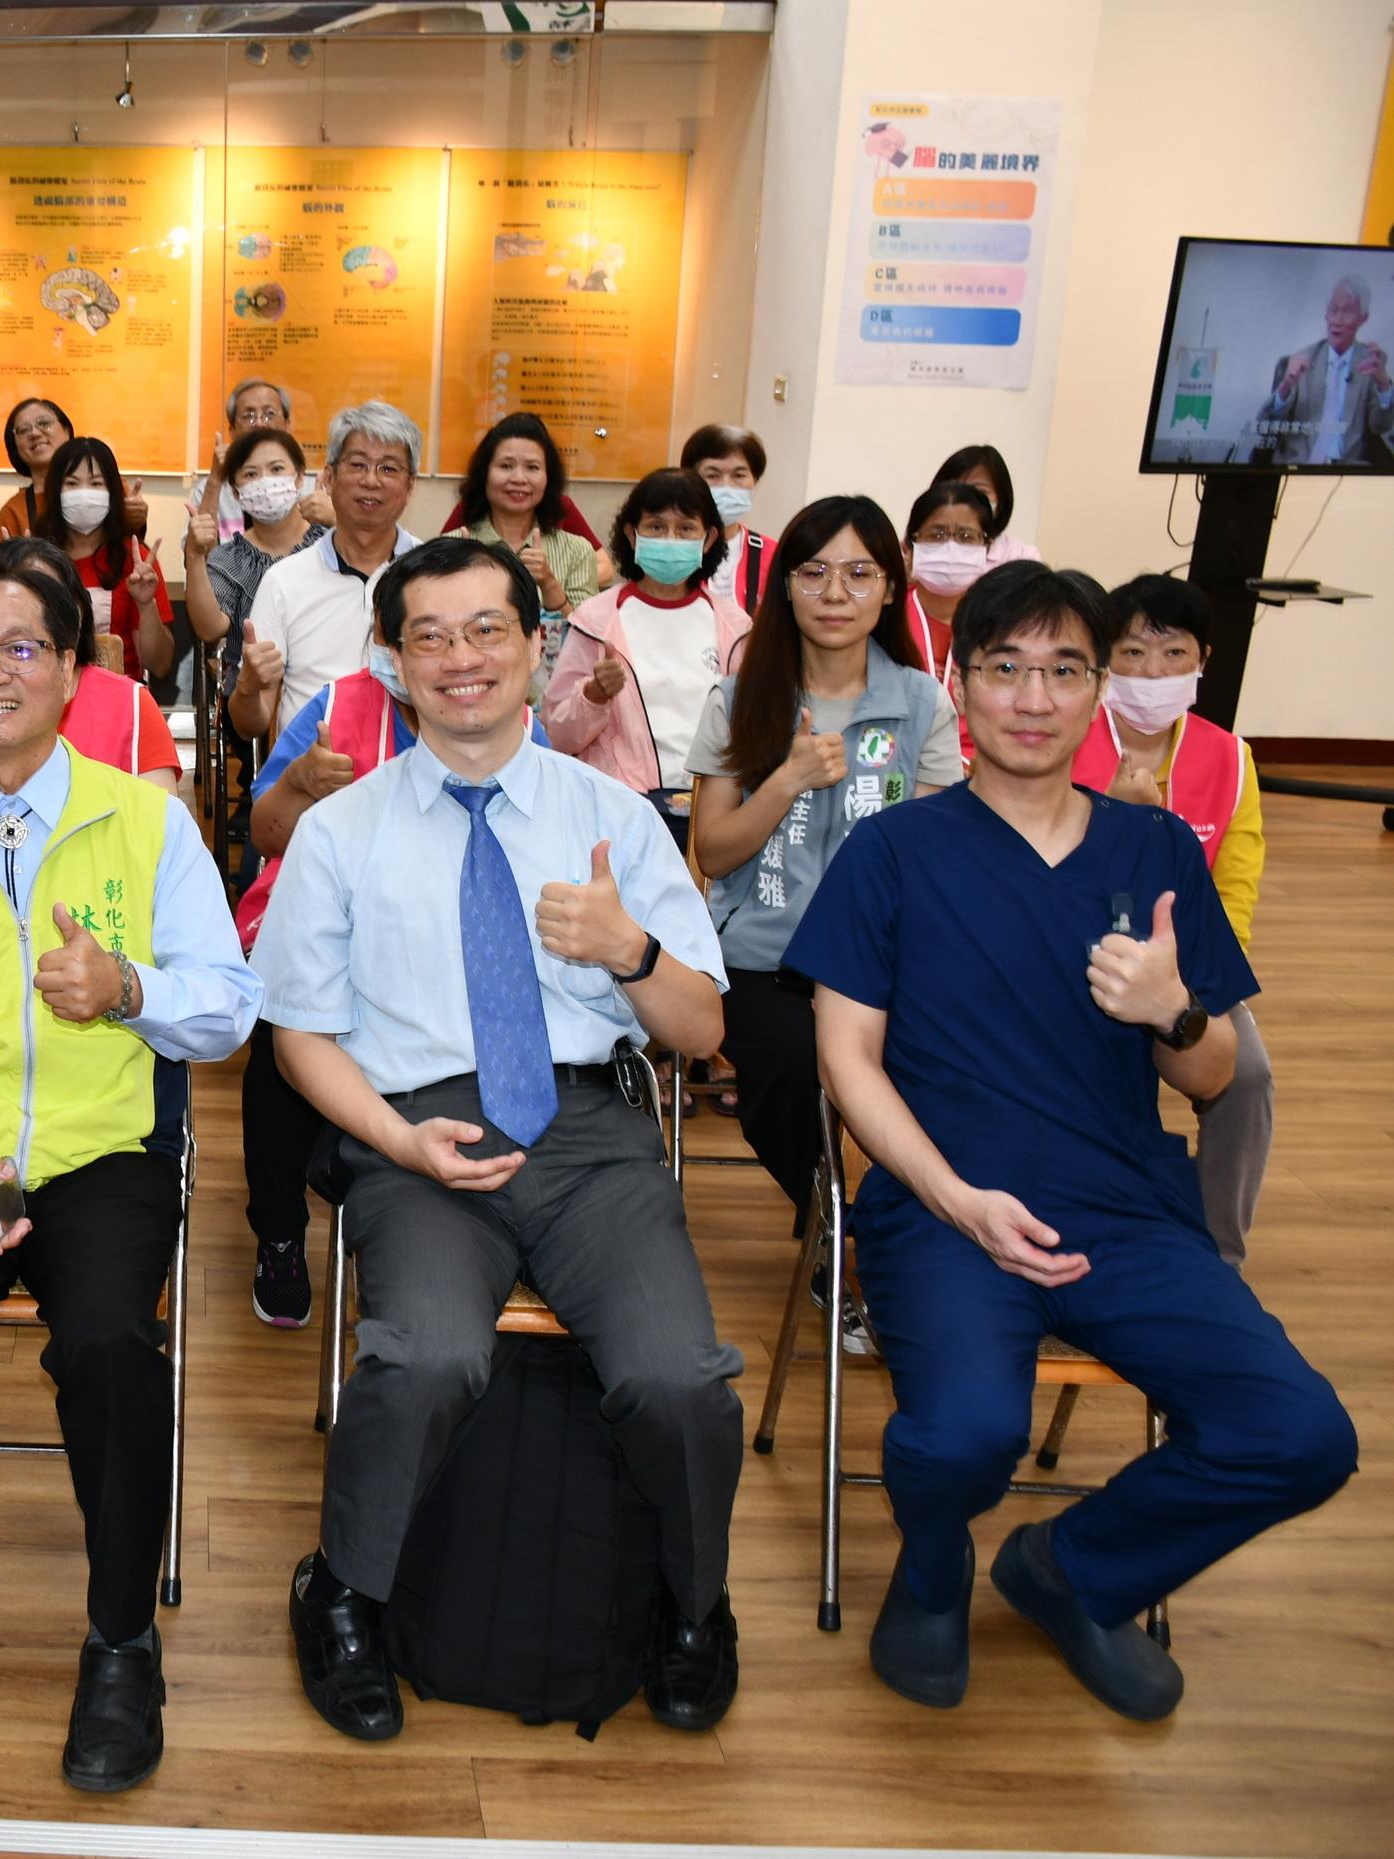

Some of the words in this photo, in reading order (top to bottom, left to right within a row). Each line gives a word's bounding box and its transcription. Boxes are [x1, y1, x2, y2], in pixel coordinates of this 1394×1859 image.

[913, 146, 1040, 172] 腦的美麗境界
[788, 790, 813, 845] 主任
[758, 816, 787, 909] 媛雅
[104, 879, 126, 951] 彰化市
